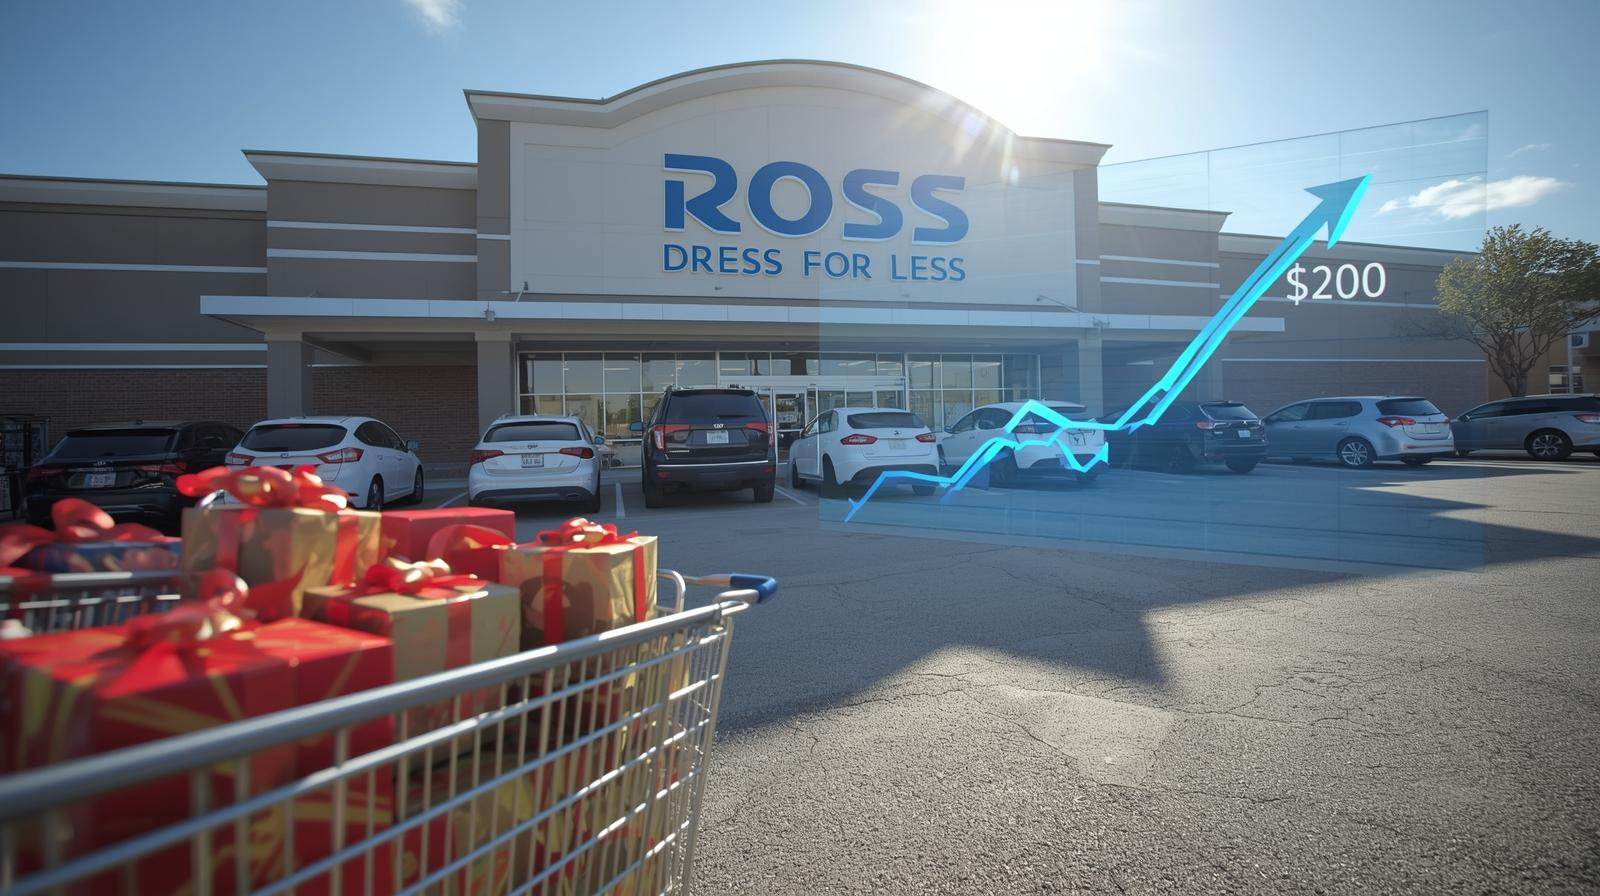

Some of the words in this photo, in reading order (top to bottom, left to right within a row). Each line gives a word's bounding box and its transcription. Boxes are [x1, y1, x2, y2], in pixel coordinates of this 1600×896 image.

[663, 153, 970, 246] ROSS
[663, 243, 783, 276] DRESS
[803, 250, 872, 280] FOR
[890, 254, 967, 282] LESS
